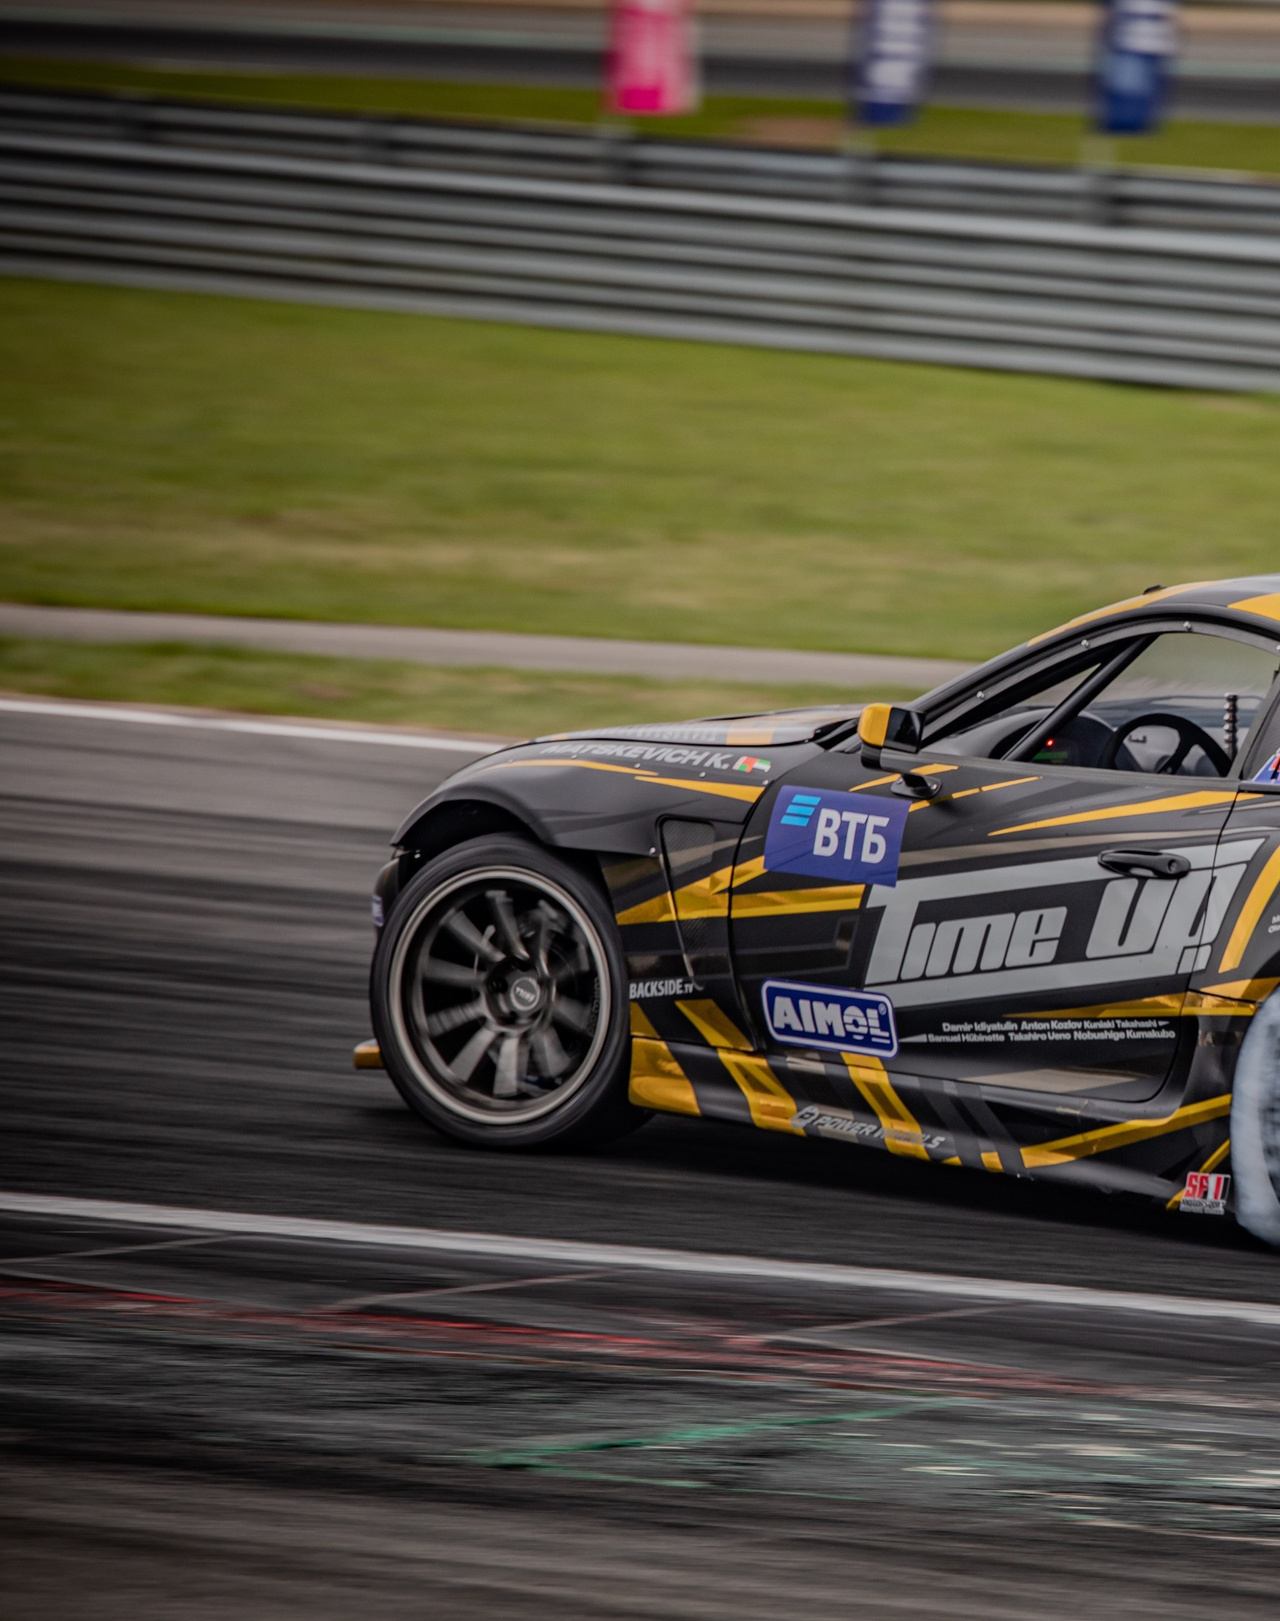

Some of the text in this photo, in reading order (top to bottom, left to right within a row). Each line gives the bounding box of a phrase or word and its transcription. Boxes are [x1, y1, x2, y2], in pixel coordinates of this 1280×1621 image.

[541, 744, 730, 770] MATSKEVICH K.
[812, 808, 889, 864] ВТБ
[864, 868, 1068, 986] Time
[629, 979, 695, 999] BACKSIDE.TV
[773, 995, 891, 1042] AIMOL
[942, 1022, 973, 1032] Damir
[1020, 1020, 1050, 1030] Anton
[1050, 1019, 1083, 1030] Kozlov
[1008, 1031, 1047, 1041] Takahiro
[1047, 1031, 1071, 1041] Ueno
[1126, 1029, 1176, 1040] Kumakubo
